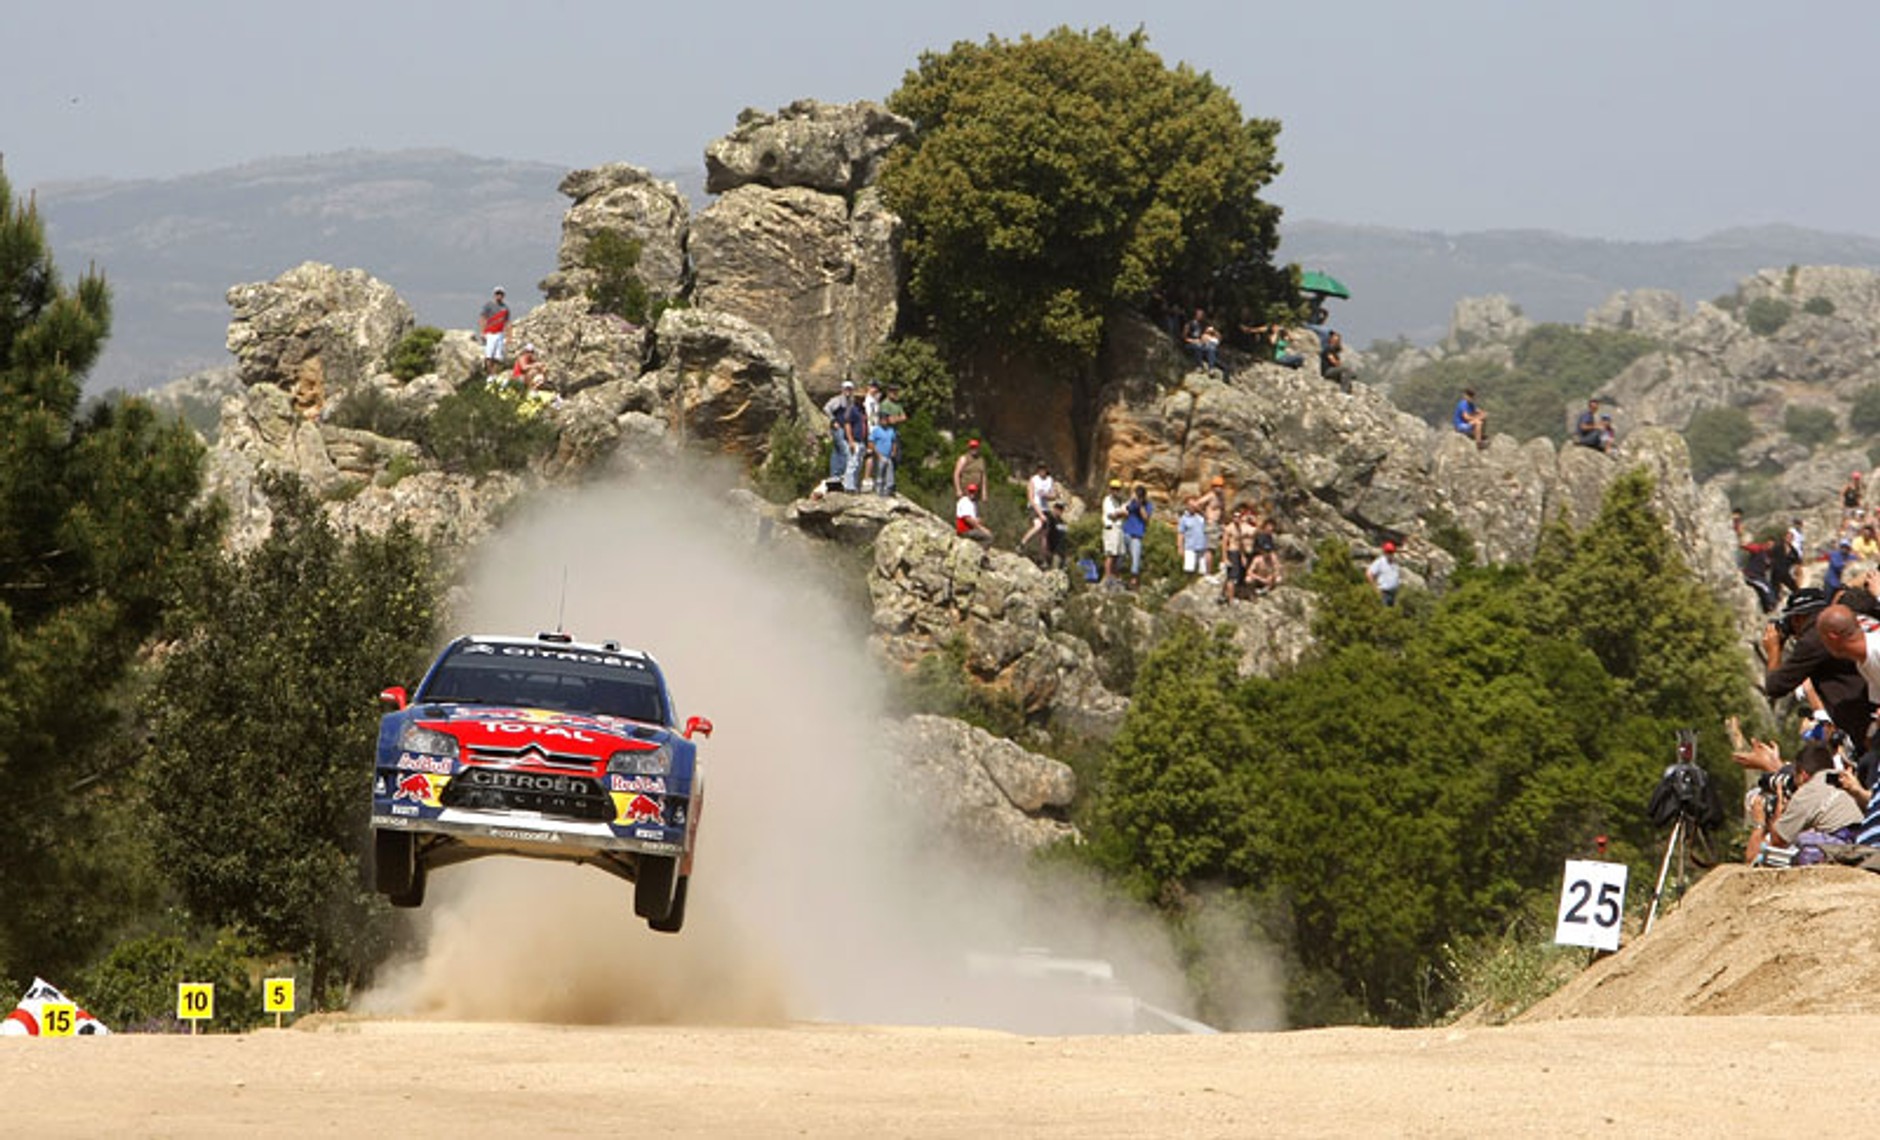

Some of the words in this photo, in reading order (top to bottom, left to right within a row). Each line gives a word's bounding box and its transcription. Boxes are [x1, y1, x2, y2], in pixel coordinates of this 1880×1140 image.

[479, 720, 595, 743] TOTAL
[1563, 878, 1621, 929] 25
[184, 990, 208, 1012] 10
[273, 985, 286, 1005] 5
[45, 1009, 71, 1033] 15
